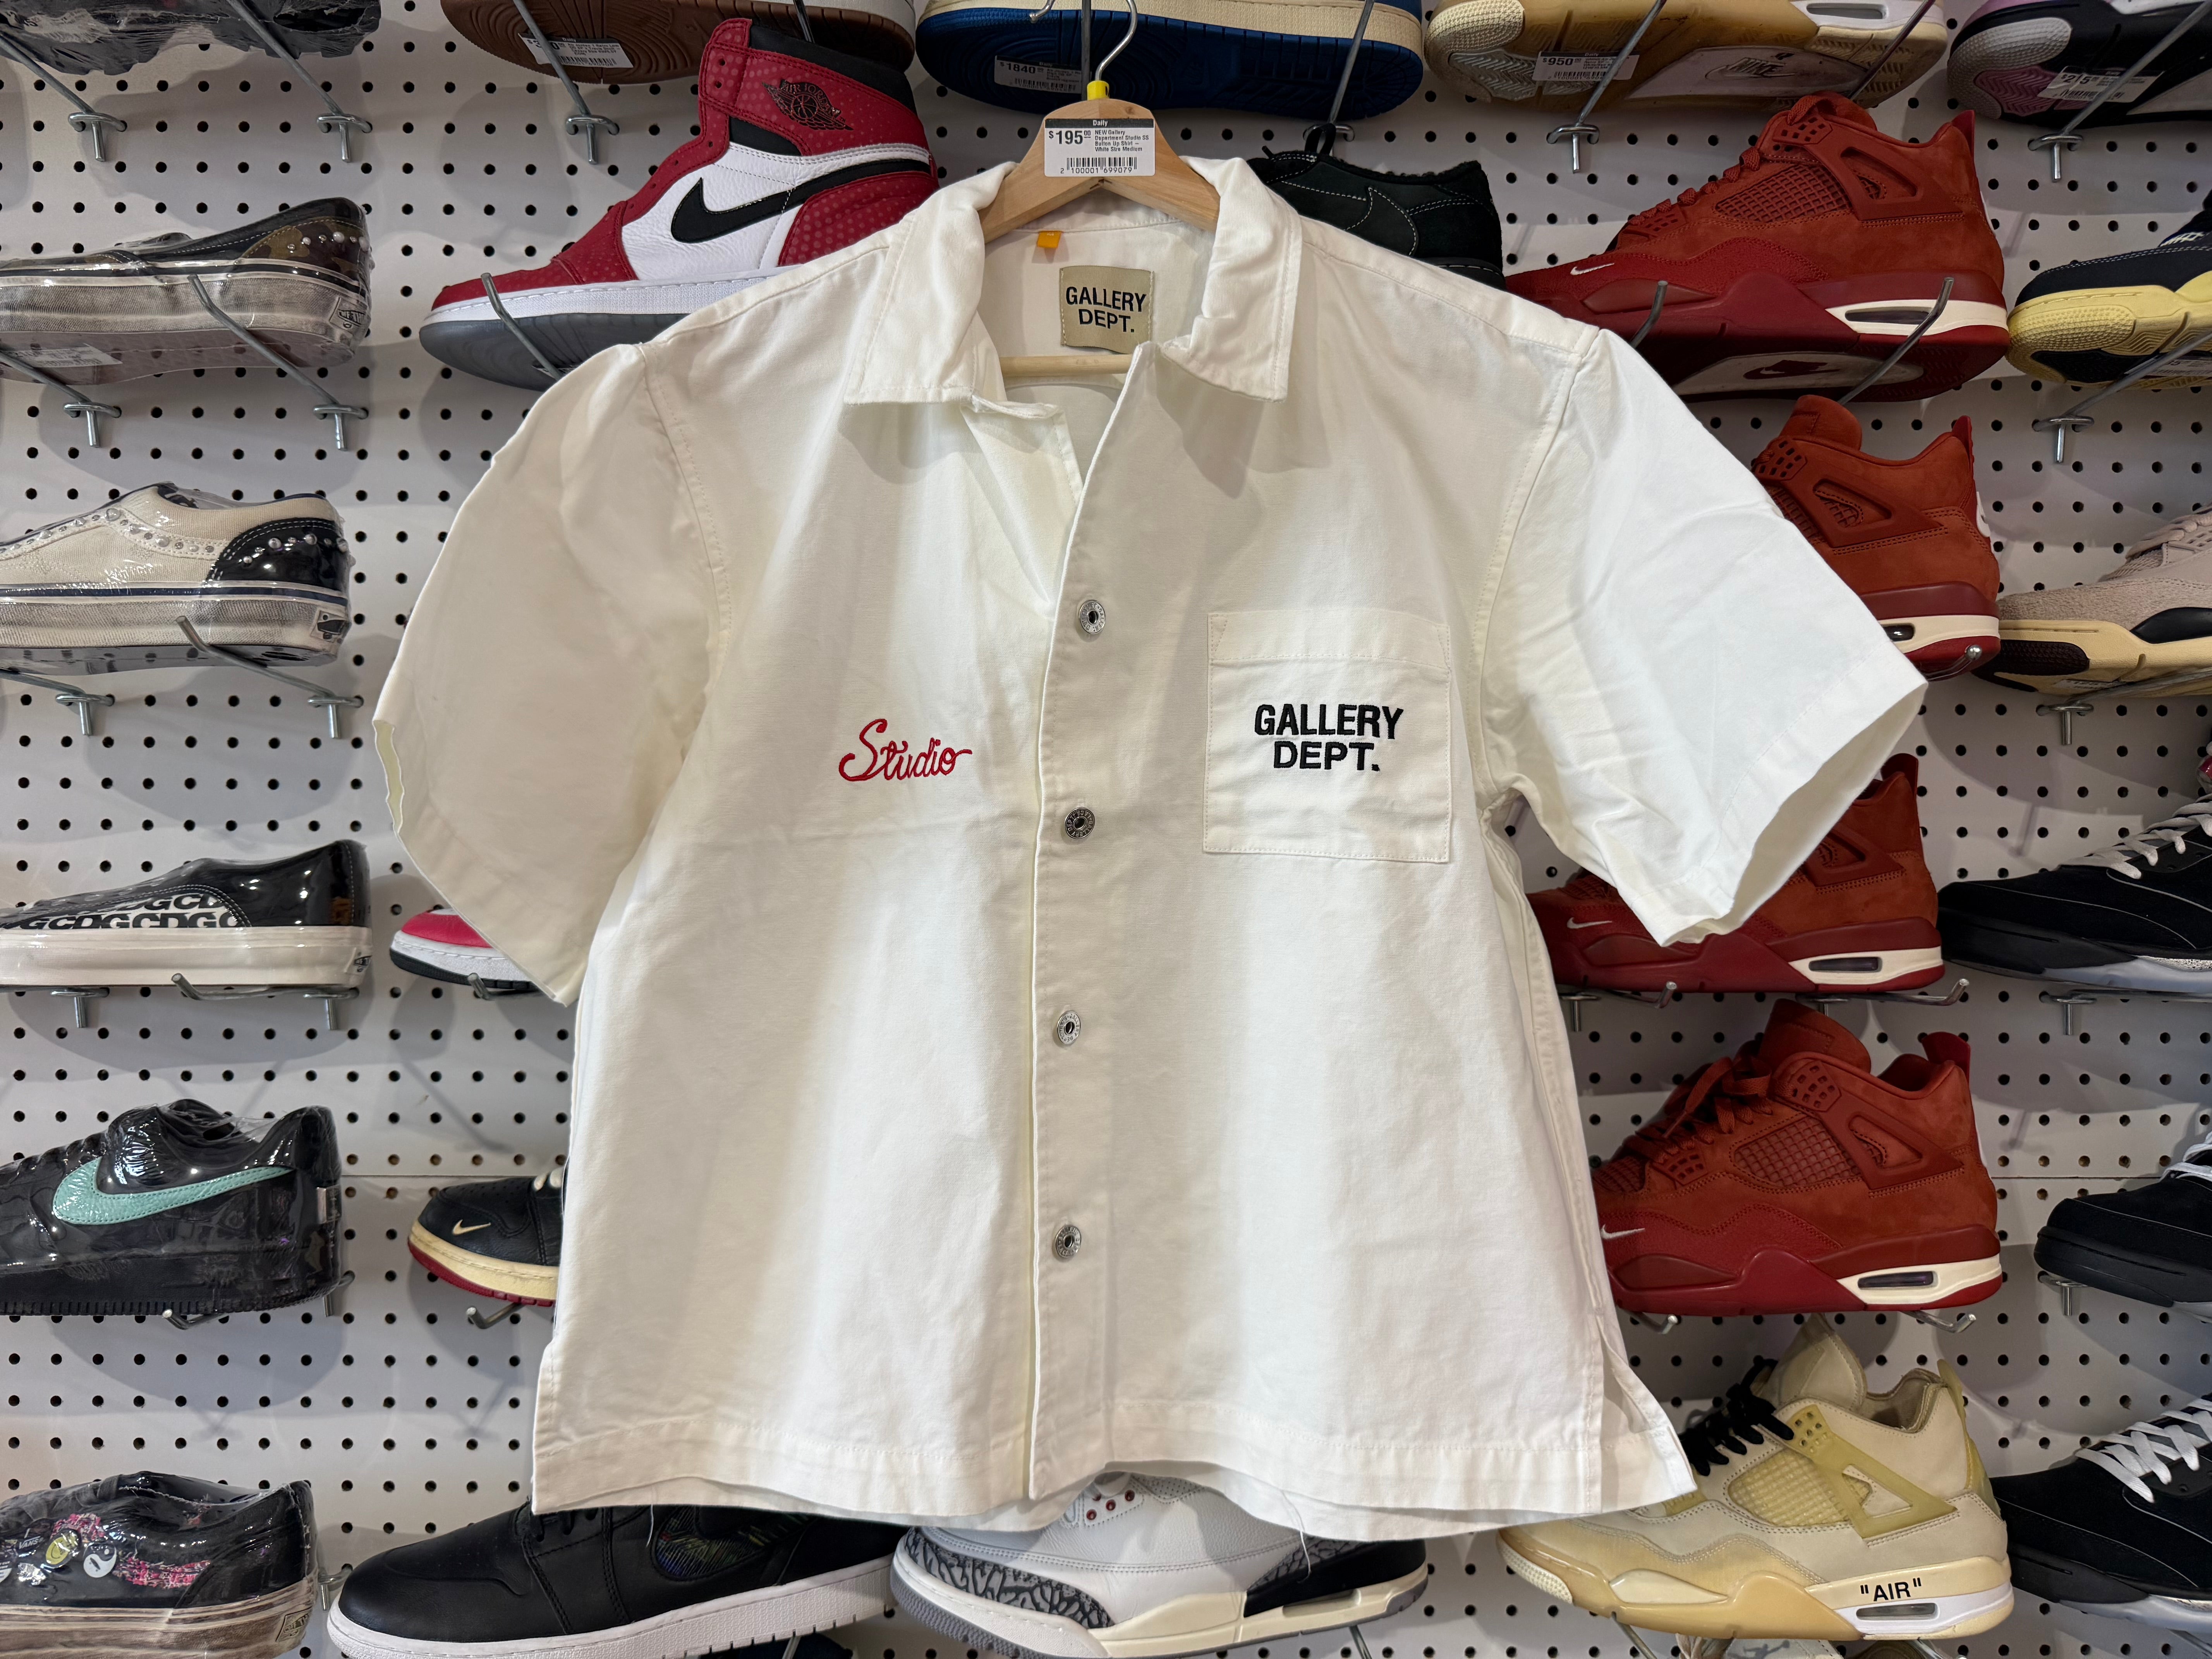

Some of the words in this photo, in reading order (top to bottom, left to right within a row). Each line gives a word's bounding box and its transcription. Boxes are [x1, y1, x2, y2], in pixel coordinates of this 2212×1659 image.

[1000, 62, 1036, 74] $1840
[1543, 57, 1574, 66] $950
[1049, 130, 1083, 145] $195
[1065, 286, 1147, 313] GALLERY
[1078, 309, 1135, 333] DEPT.
[1254, 704, 1405, 740] GALLERY
[838, 718, 973, 782] Studio
[1273, 740, 1381, 772] DEPT.
[19, 1535, 40, 1550] VANS
[1860, 1577, 1922, 1602] "AIR"
